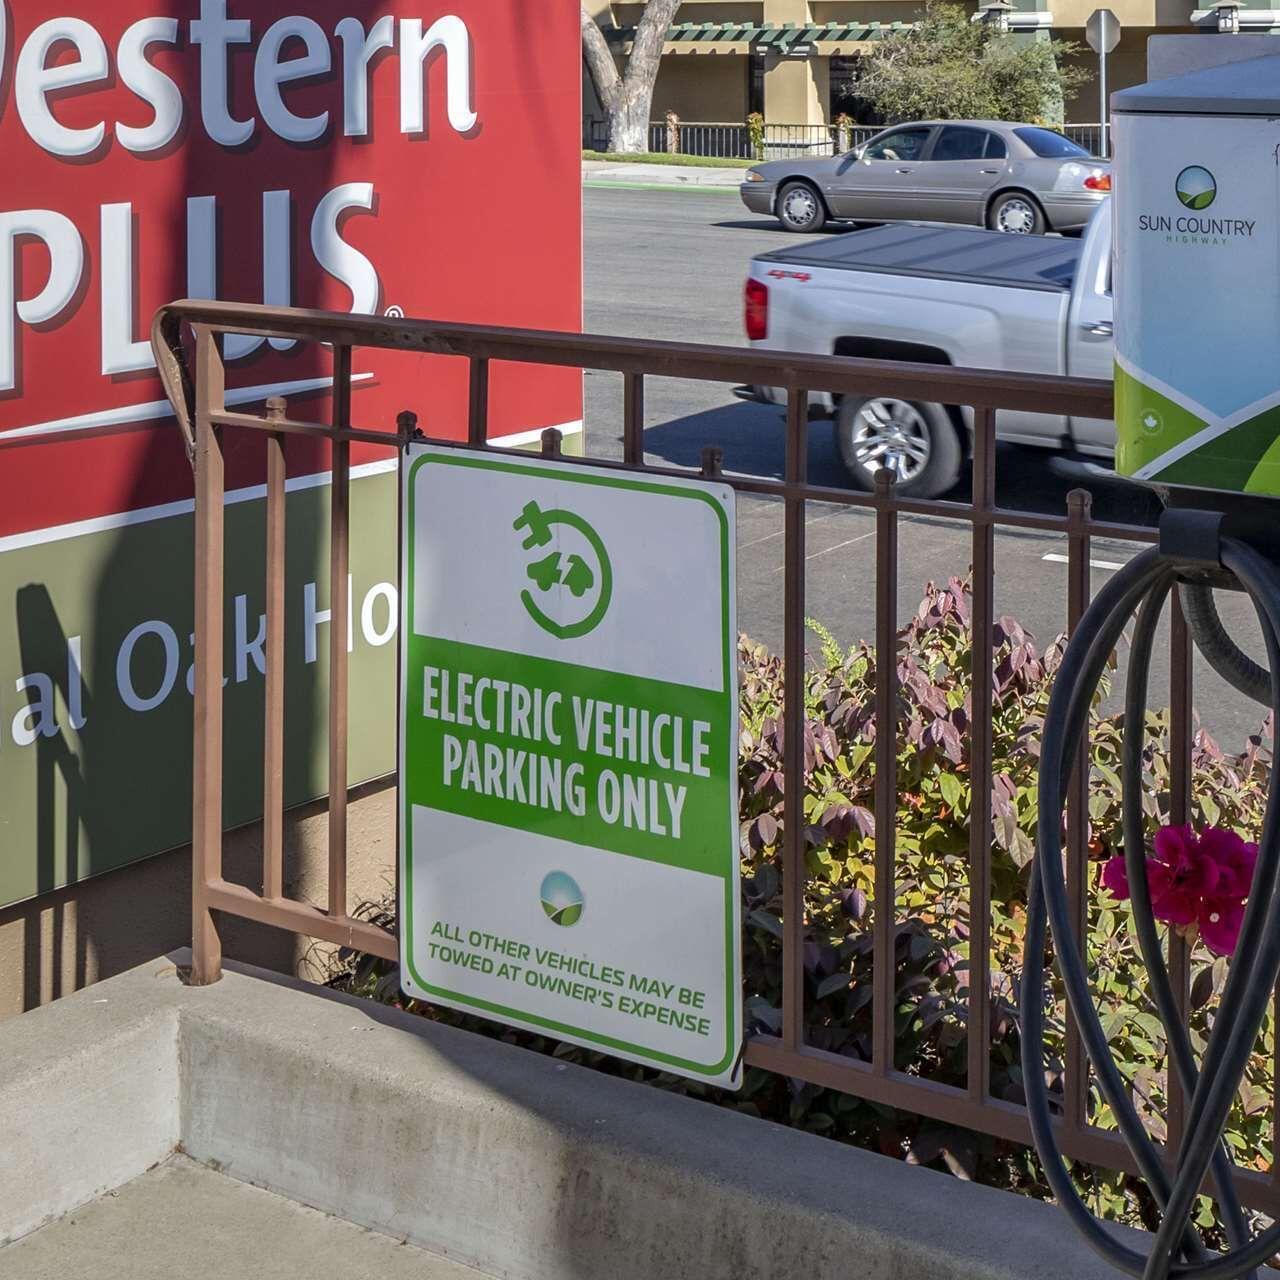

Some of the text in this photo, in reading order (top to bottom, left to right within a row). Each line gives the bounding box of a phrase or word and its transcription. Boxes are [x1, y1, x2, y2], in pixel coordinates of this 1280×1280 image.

[1139, 215, 1256, 236] SUN COUNTRY
[1166, 235, 1228, 246] HIGHWAY
[115, 593, 266, 712] Ok
[423, 666, 711, 777] ELECTRIC VEHICLE
[443, 734, 687, 839] PARKING ONLY
[428, 943, 711, 1036] TOWED AT OWNER'S EXPENSE
[430, 921, 706, 1009] ALL OTHER VEHICLES MAY BE
